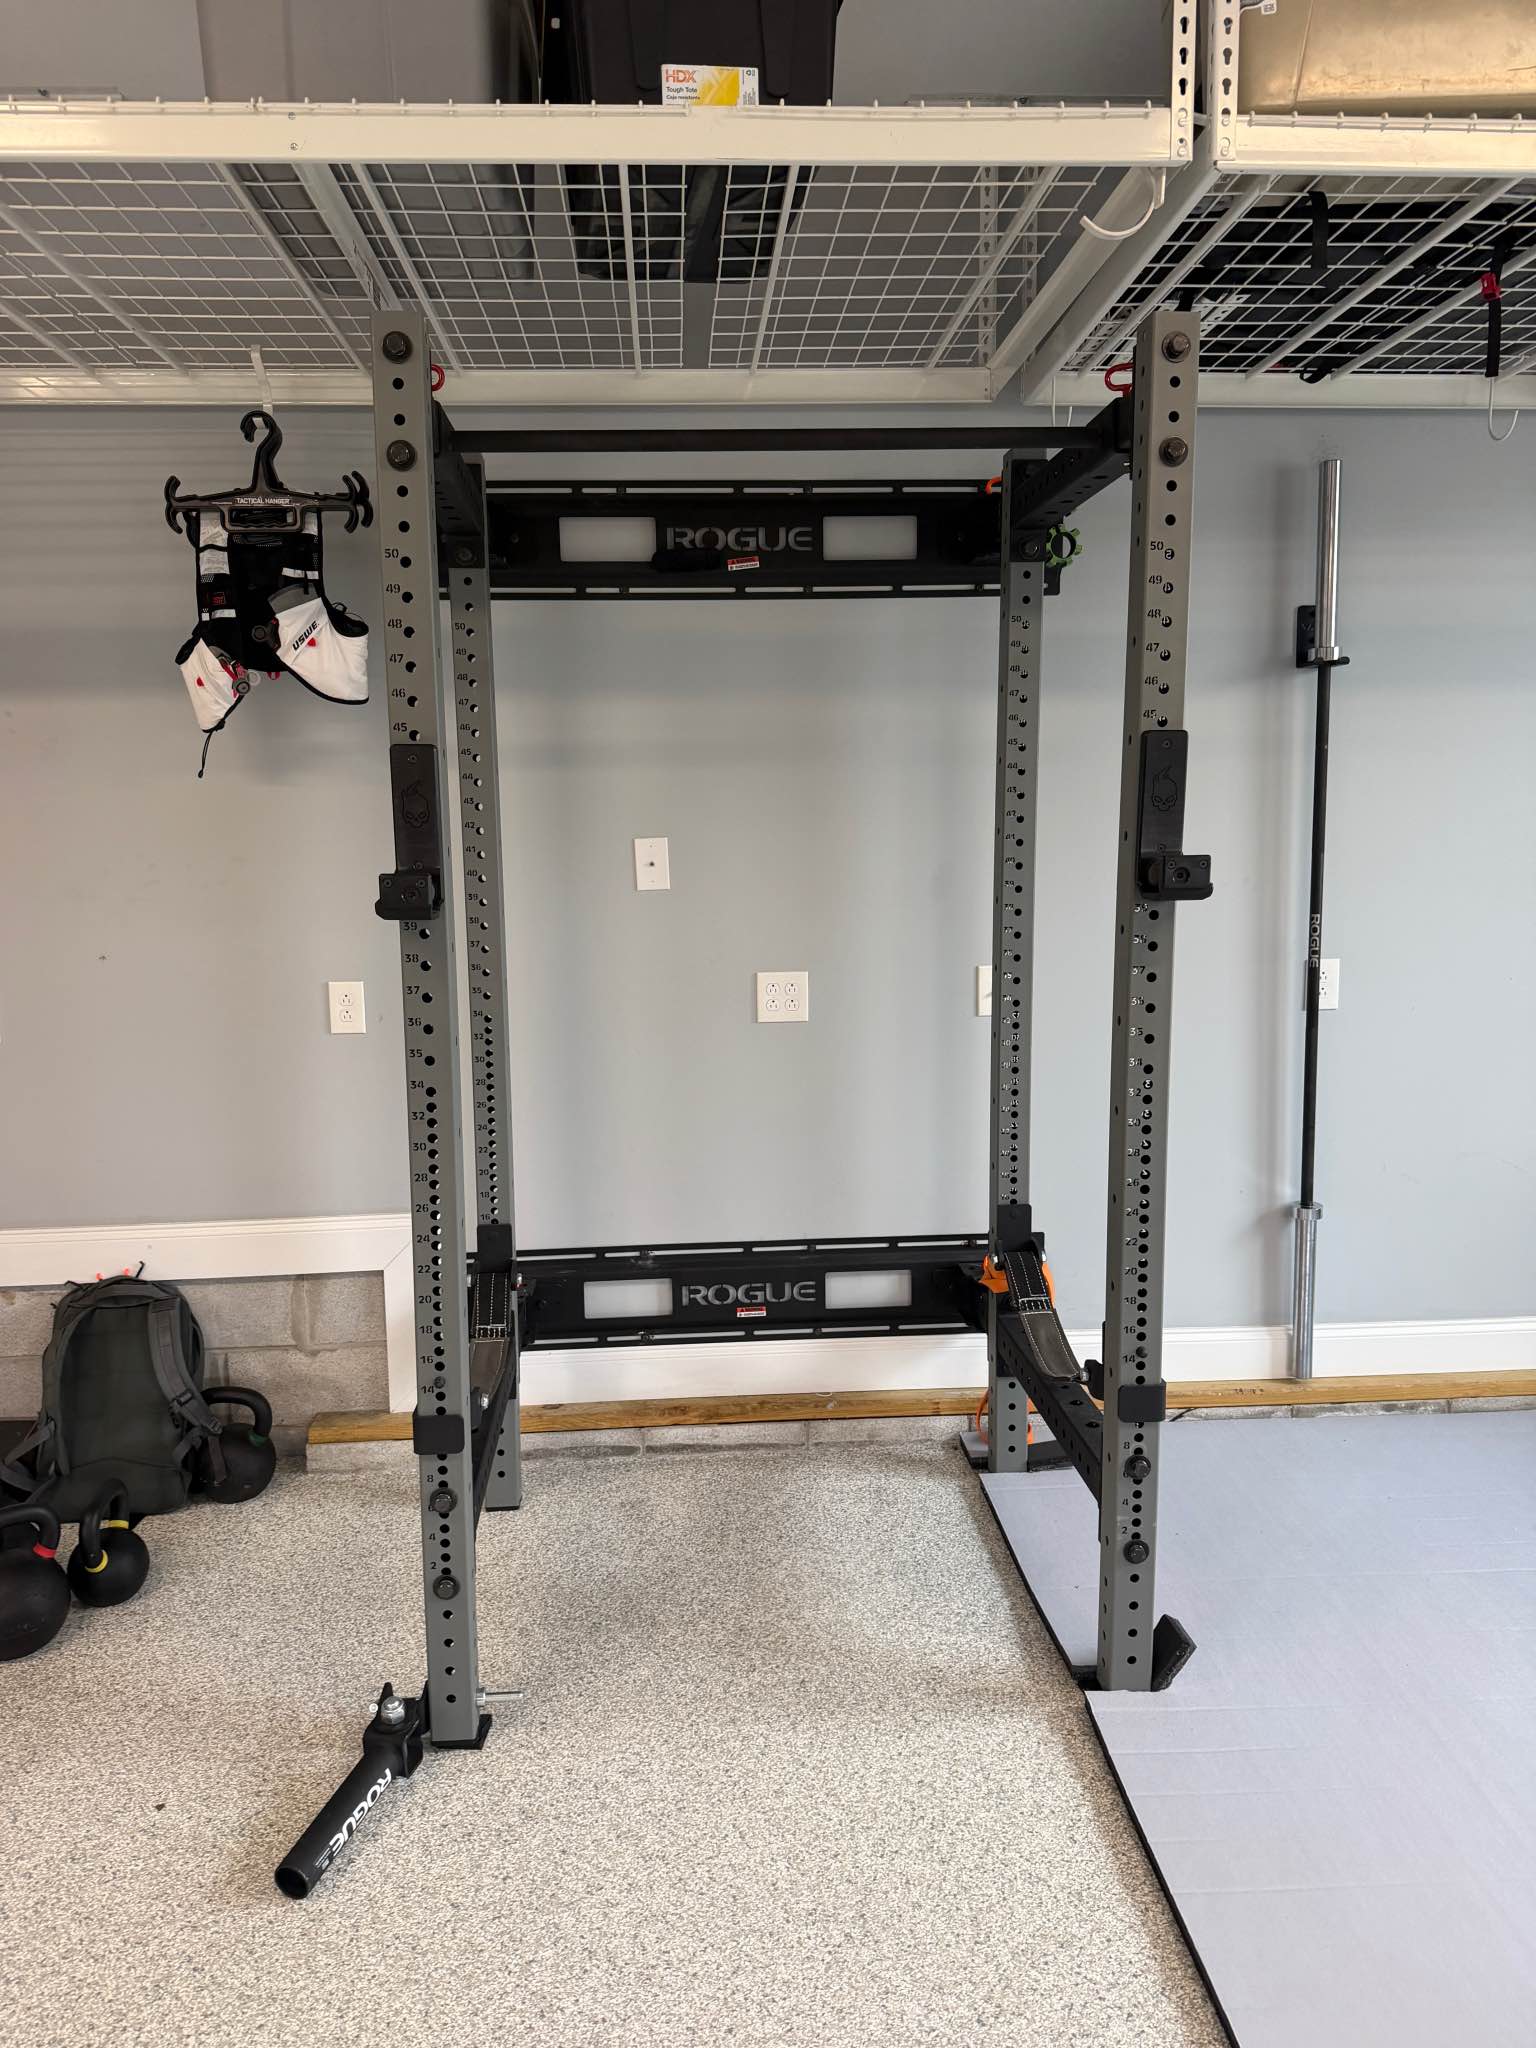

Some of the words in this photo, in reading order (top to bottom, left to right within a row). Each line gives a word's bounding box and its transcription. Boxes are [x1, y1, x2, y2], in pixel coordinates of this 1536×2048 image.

[666, 69, 696, 83] HDX
[666, 527, 814, 551] ROGUE
[1150, 541, 1164, 550] 50
[385, 548, 399, 559] 50
[1148, 575, 1162, 584] 49
[385, 584, 401, 594] 49
[1147, 609, 1161, 618] 48
[387, 619, 403, 629] 48
[292, 620, 318, 651] USWE
[1146, 643, 1159, 652] 47
[390, 654, 404, 663] 47
[1144, 676, 1158, 685] 46
[392, 688, 406, 698] 46
[1143, 710, 1157, 718] 45
[393, 722, 407, 732] 45
[404, 922, 417, 931] 39
[1310, 914, 1320, 968] ROGUE
[405, 954, 419, 963] 38
[406, 986, 420, 994] 37
[407, 1018, 422, 1026] 36
[409, 1049, 423, 1057] 35
[410, 1081, 424, 1089] 34
[412, 1112, 425, 1120] 32
[413, 1142, 427, 1151] 30
[414, 1174, 428, 1182] 28
[415, 1204, 429, 1212] 26
[416, 1235, 430, 1243] 24
[418, 1265, 431, 1273] 22
[682, 1281, 816, 1306] ROGUE
[419, 1295, 432, 1304] 20
[420, 1356, 433, 1364] 16
[1123, 1355, 1135, 1363] 14
[329, 1768, 392, 1856] ROGUE
